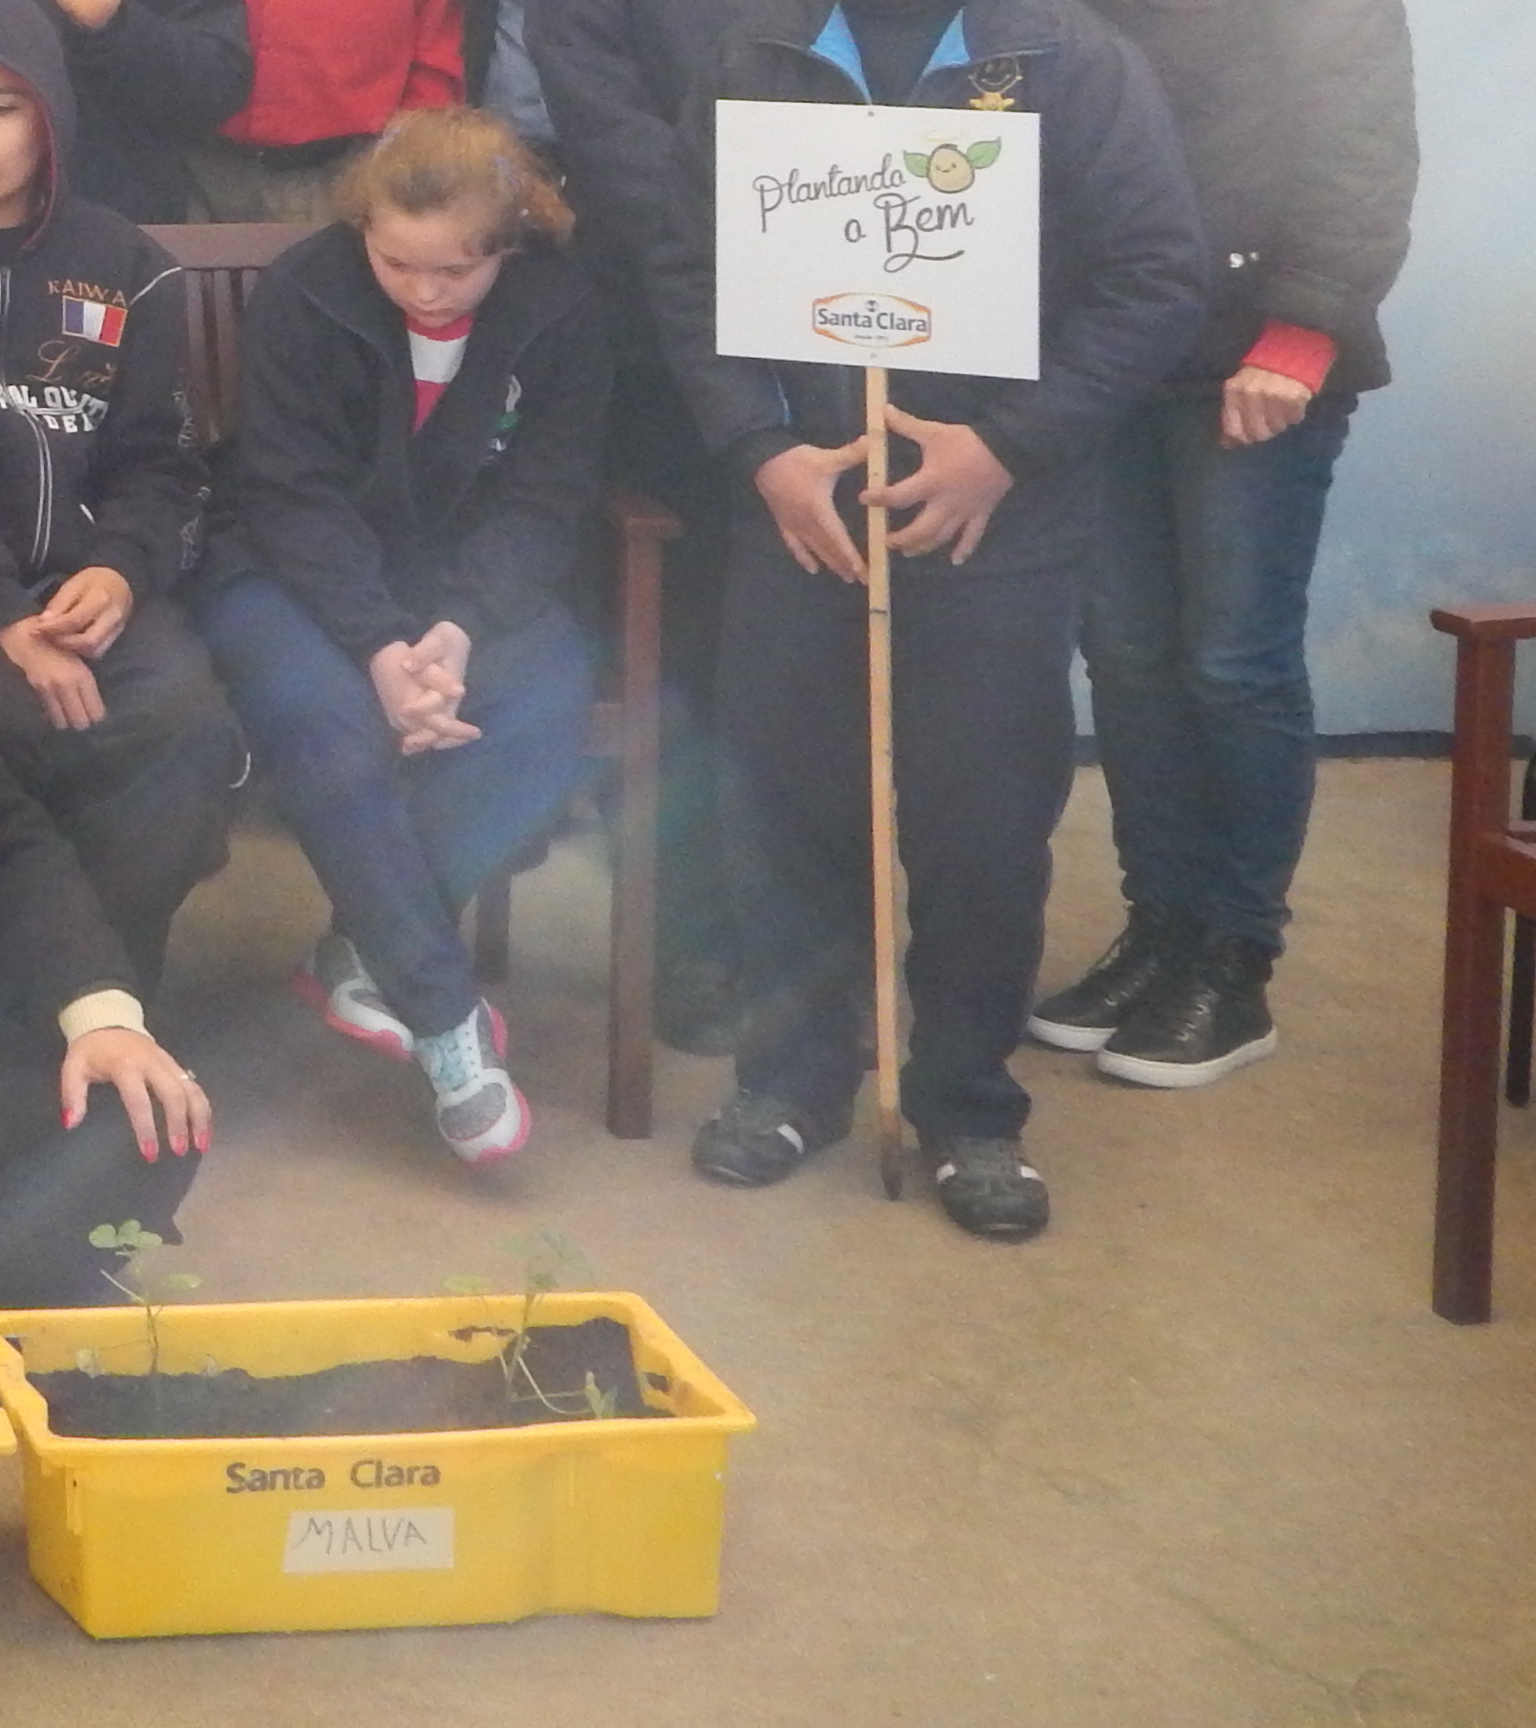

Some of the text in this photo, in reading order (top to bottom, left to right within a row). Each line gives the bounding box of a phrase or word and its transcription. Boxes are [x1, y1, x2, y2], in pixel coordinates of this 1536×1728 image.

[753, 153, 906, 233] Plantando
[874, 193, 974, 273] Bem
[818, 308, 928, 332] Santa Clara
[226, 1459, 441, 1494] Santa Clara
[291, 1516, 428, 1555] MALVA
